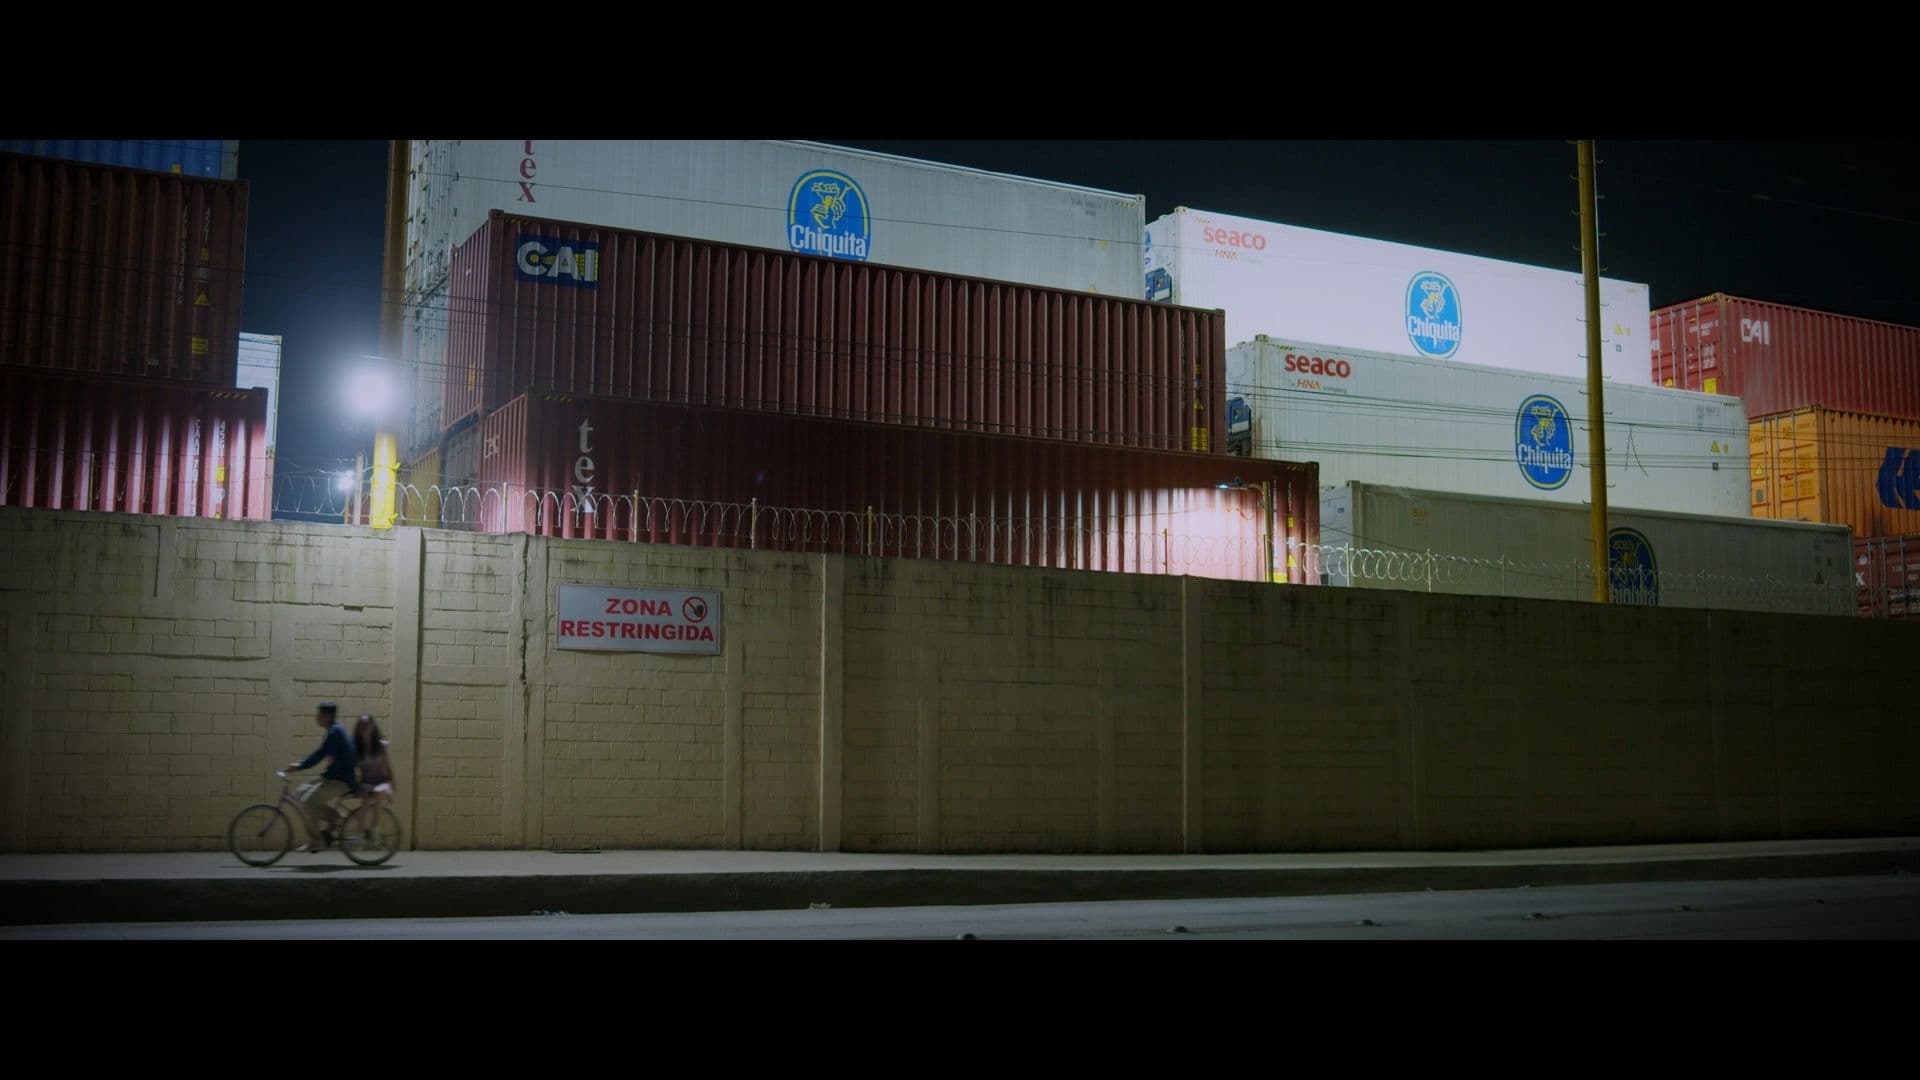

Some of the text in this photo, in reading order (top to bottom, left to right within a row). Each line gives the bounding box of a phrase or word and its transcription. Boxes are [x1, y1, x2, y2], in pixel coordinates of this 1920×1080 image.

[791, 224, 867, 257] Chiquita
[1203, 226, 1266, 250] seaco
[517, 240, 597, 281] CAI
[1408, 315, 1460, 349] Chiquita
[1740, 318, 1769, 345] CAI
[1284, 353, 1351, 378] seaco
[572, 418, 596, 513] tex
[1518, 443, 1571, 474] Chiquita
[605, 598, 672, 616] ZONA
[560, 620, 714, 641] RESTRINGIDA
